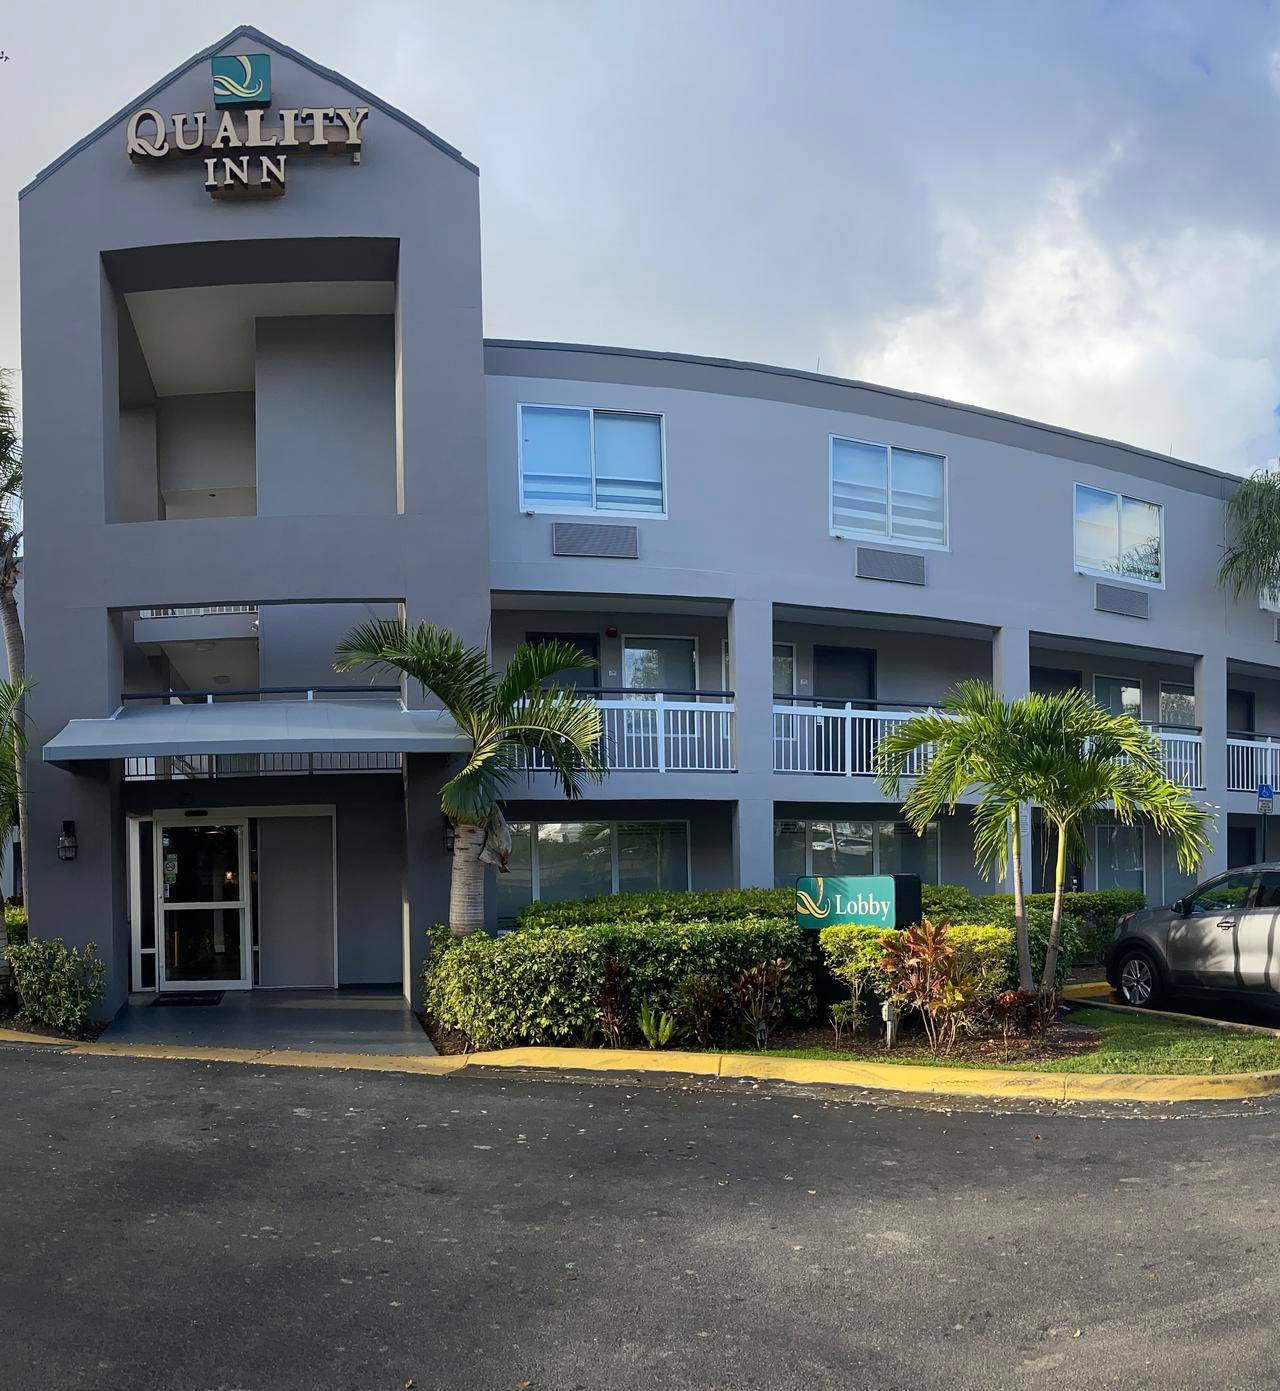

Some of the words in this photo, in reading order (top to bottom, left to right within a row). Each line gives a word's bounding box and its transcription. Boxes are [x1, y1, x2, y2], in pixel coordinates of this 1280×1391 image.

[127, 107, 369, 157] QUALITY
[204, 154, 287, 187] INN
[835, 893, 891, 921] Lobby
